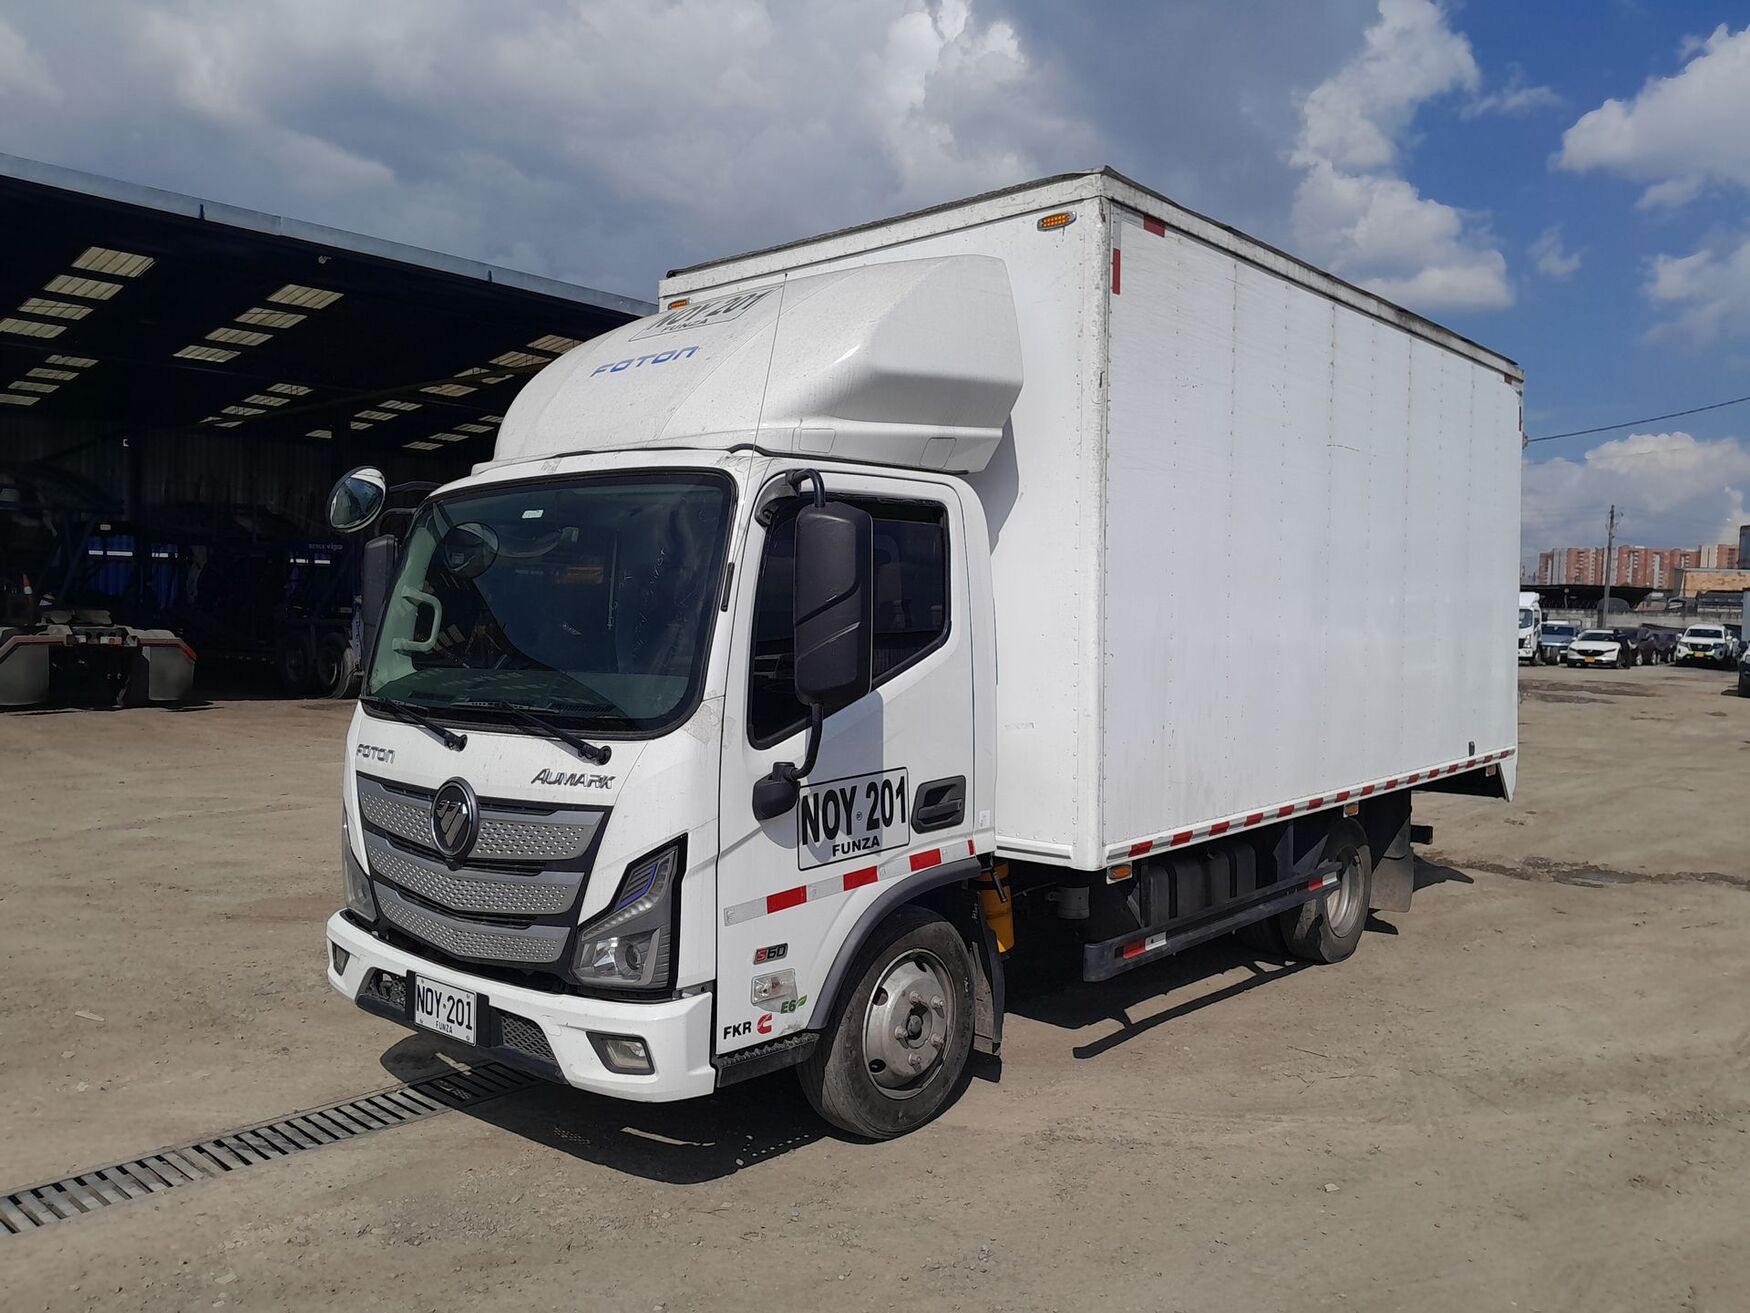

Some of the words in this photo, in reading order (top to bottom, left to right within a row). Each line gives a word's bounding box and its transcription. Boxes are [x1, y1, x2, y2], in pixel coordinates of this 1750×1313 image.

[590, 346, 699, 377] FOTON
[356, 743, 395, 764] FOTON
[531, 768, 617, 789] AUMARK
[802, 785, 858, 845] NOY
[865, 776, 906, 831] 201
[832, 835, 880, 857] FUNZA
[781, 999, 797, 1014] E6
[435, 1020, 453, 1034] FUNZA
[723, 1021, 752, 1040] FKR
